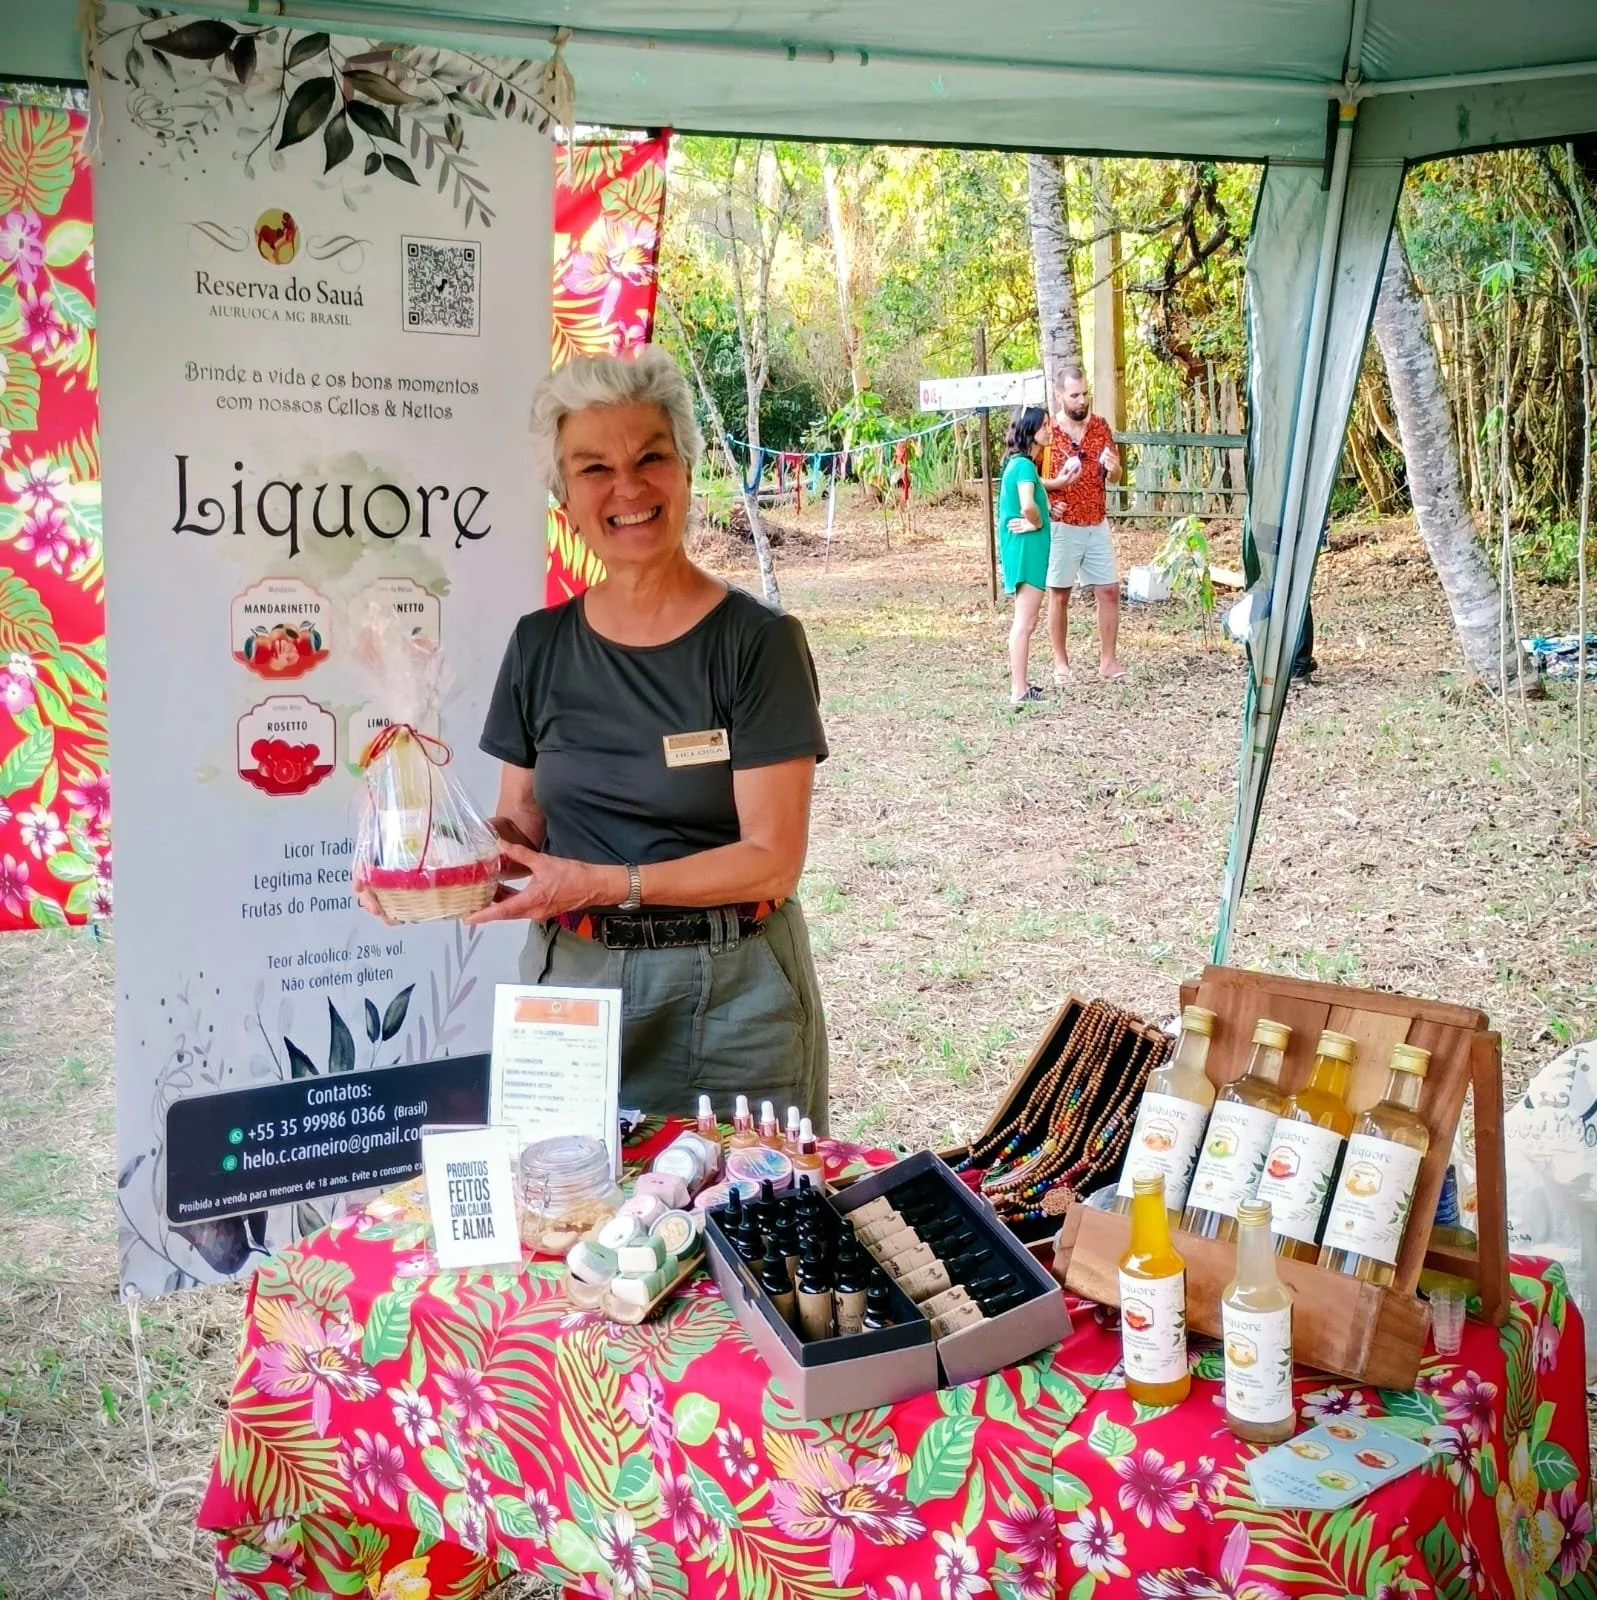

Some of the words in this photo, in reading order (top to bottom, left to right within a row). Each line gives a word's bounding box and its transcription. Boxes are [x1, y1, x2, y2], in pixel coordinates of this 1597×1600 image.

[195, 270, 279, 301] Reserva
[285, 276, 311, 303] do
[316, 279, 364, 307] Sauá
[209, 305, 280, 321] AIURUOCA
[285, 310, 305, 323] MG
[310, 312, 352, 327] BRASIL
[185, 361, 246, 384] Brinde
[252, 370, 263, 384] a
[268, 367, 306, 386] vida
[311, 373, 321, 390] e
[326, 374, 346, 388] os
[351, 372, 393, 391] bons
[398, 377, 479, 395] momentos
[216, 395, 253, 410] com
[259, 397, 323, 414] nossos
[328, 396, 380, 417] Cellos
[384, 400, 397, 417] &
[402, 400, 453, 420] Nettos
[172, 455, 492, 559] Liquore
[244, 603, 320, 614] MANDARINETTO
[393, 603, 424, 613] NETTO
[267, 720, 308, 732] ROSETTO
[284, 843, 315, 859] Licor
[254, 870, 312, 892] Legítima
[242, 901, 282, 919] Frutas
[287, 897, 305, 914] do
[310, 896, 352, 912] Pomar
[268, 955, 292, 969] Teor
[297, 949, 352, 966] alcoólico:
[357, 945, 382, 959] 28%
[385, 941, 406, 955] vol.
[281, 977, 305, 991] Não
[309, 971, 353, 989] contém
[357, 968, 393, 986] glúten
[307, 1084, 372, 1106] Contatos:
[248, 1122, 275, 1142] +55
[280, 1119, 298, 1137] 35
[302, 1110, 346, 1133] 99986
[351, 1104, 386, 1125] 0366
[393, 1100, 428, 1121] (Brasil)
[446, 1160, 488, 1178] PRODUTOS
[179, 1198, 213, 1214] Proibida
[214, 1199, 220, 1207] a
[222, 1192, 248, 1205] venda
[249, 1189, 267, 1203] para
[269, 1182, 304, 1197] menores
[306, 1180, 316, 1190] de
[319, 1178, 328, 1188] 18
[329, 1174, 350, 1186] anos.
[352, 1170, 370, 1182] Evite
[372, 1170, 378, 1178] o
[379, 1163, 413, 1177] consumo
[448, 1177, 490, 1203] FEITOS
[450, 1203, 466, 1217] COM
[467, 1201, 493, 1216] CALMA
[452, 1219, 460, 1240] E
[463, 1217, 495, 1240] ALMA
